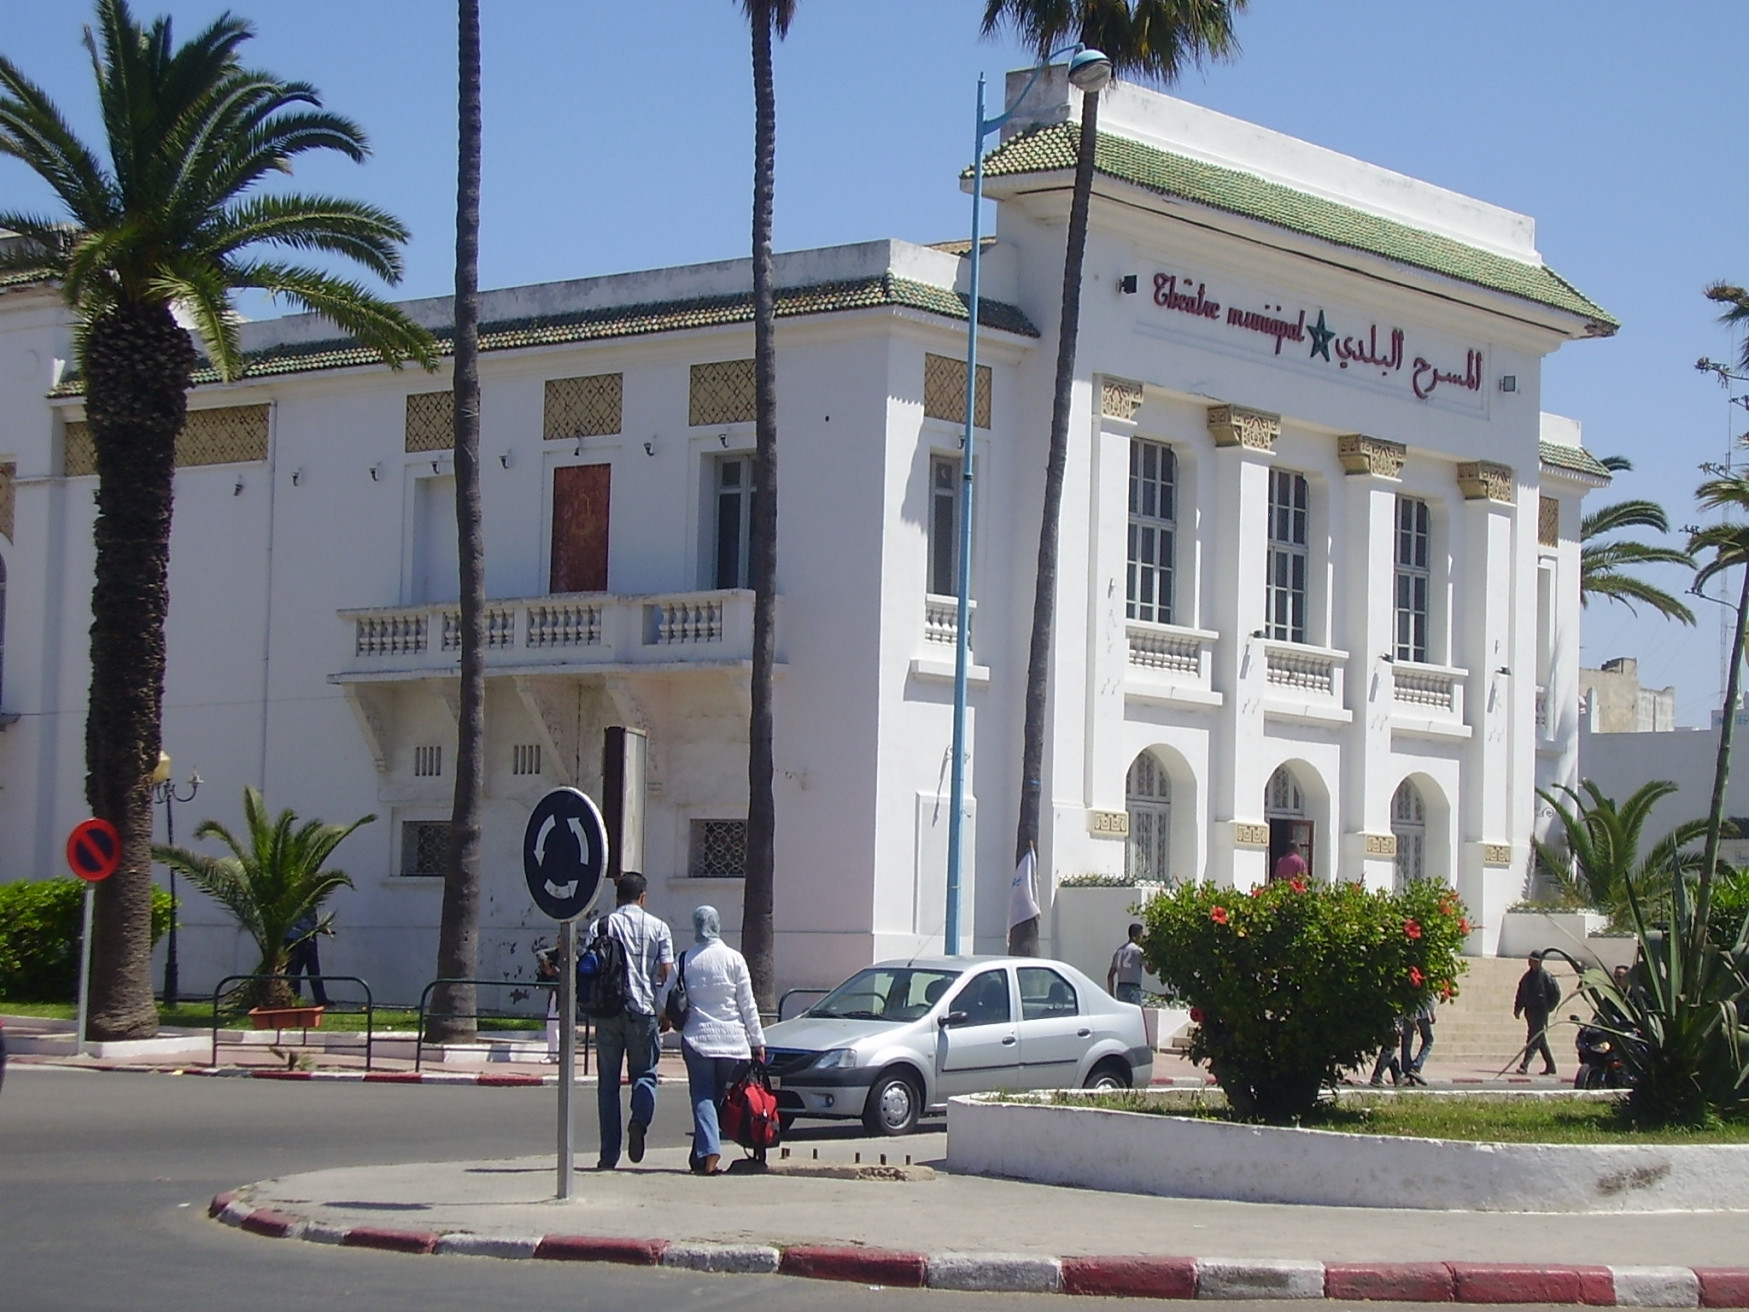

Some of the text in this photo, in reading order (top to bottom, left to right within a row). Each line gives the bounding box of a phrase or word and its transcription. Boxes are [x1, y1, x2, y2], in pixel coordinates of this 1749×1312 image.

[1227, 304, 1306, 355] municipal
[1335, 324, 1482, 400] المسرح البلدي
[1117, 950, 1132, 969] 12
